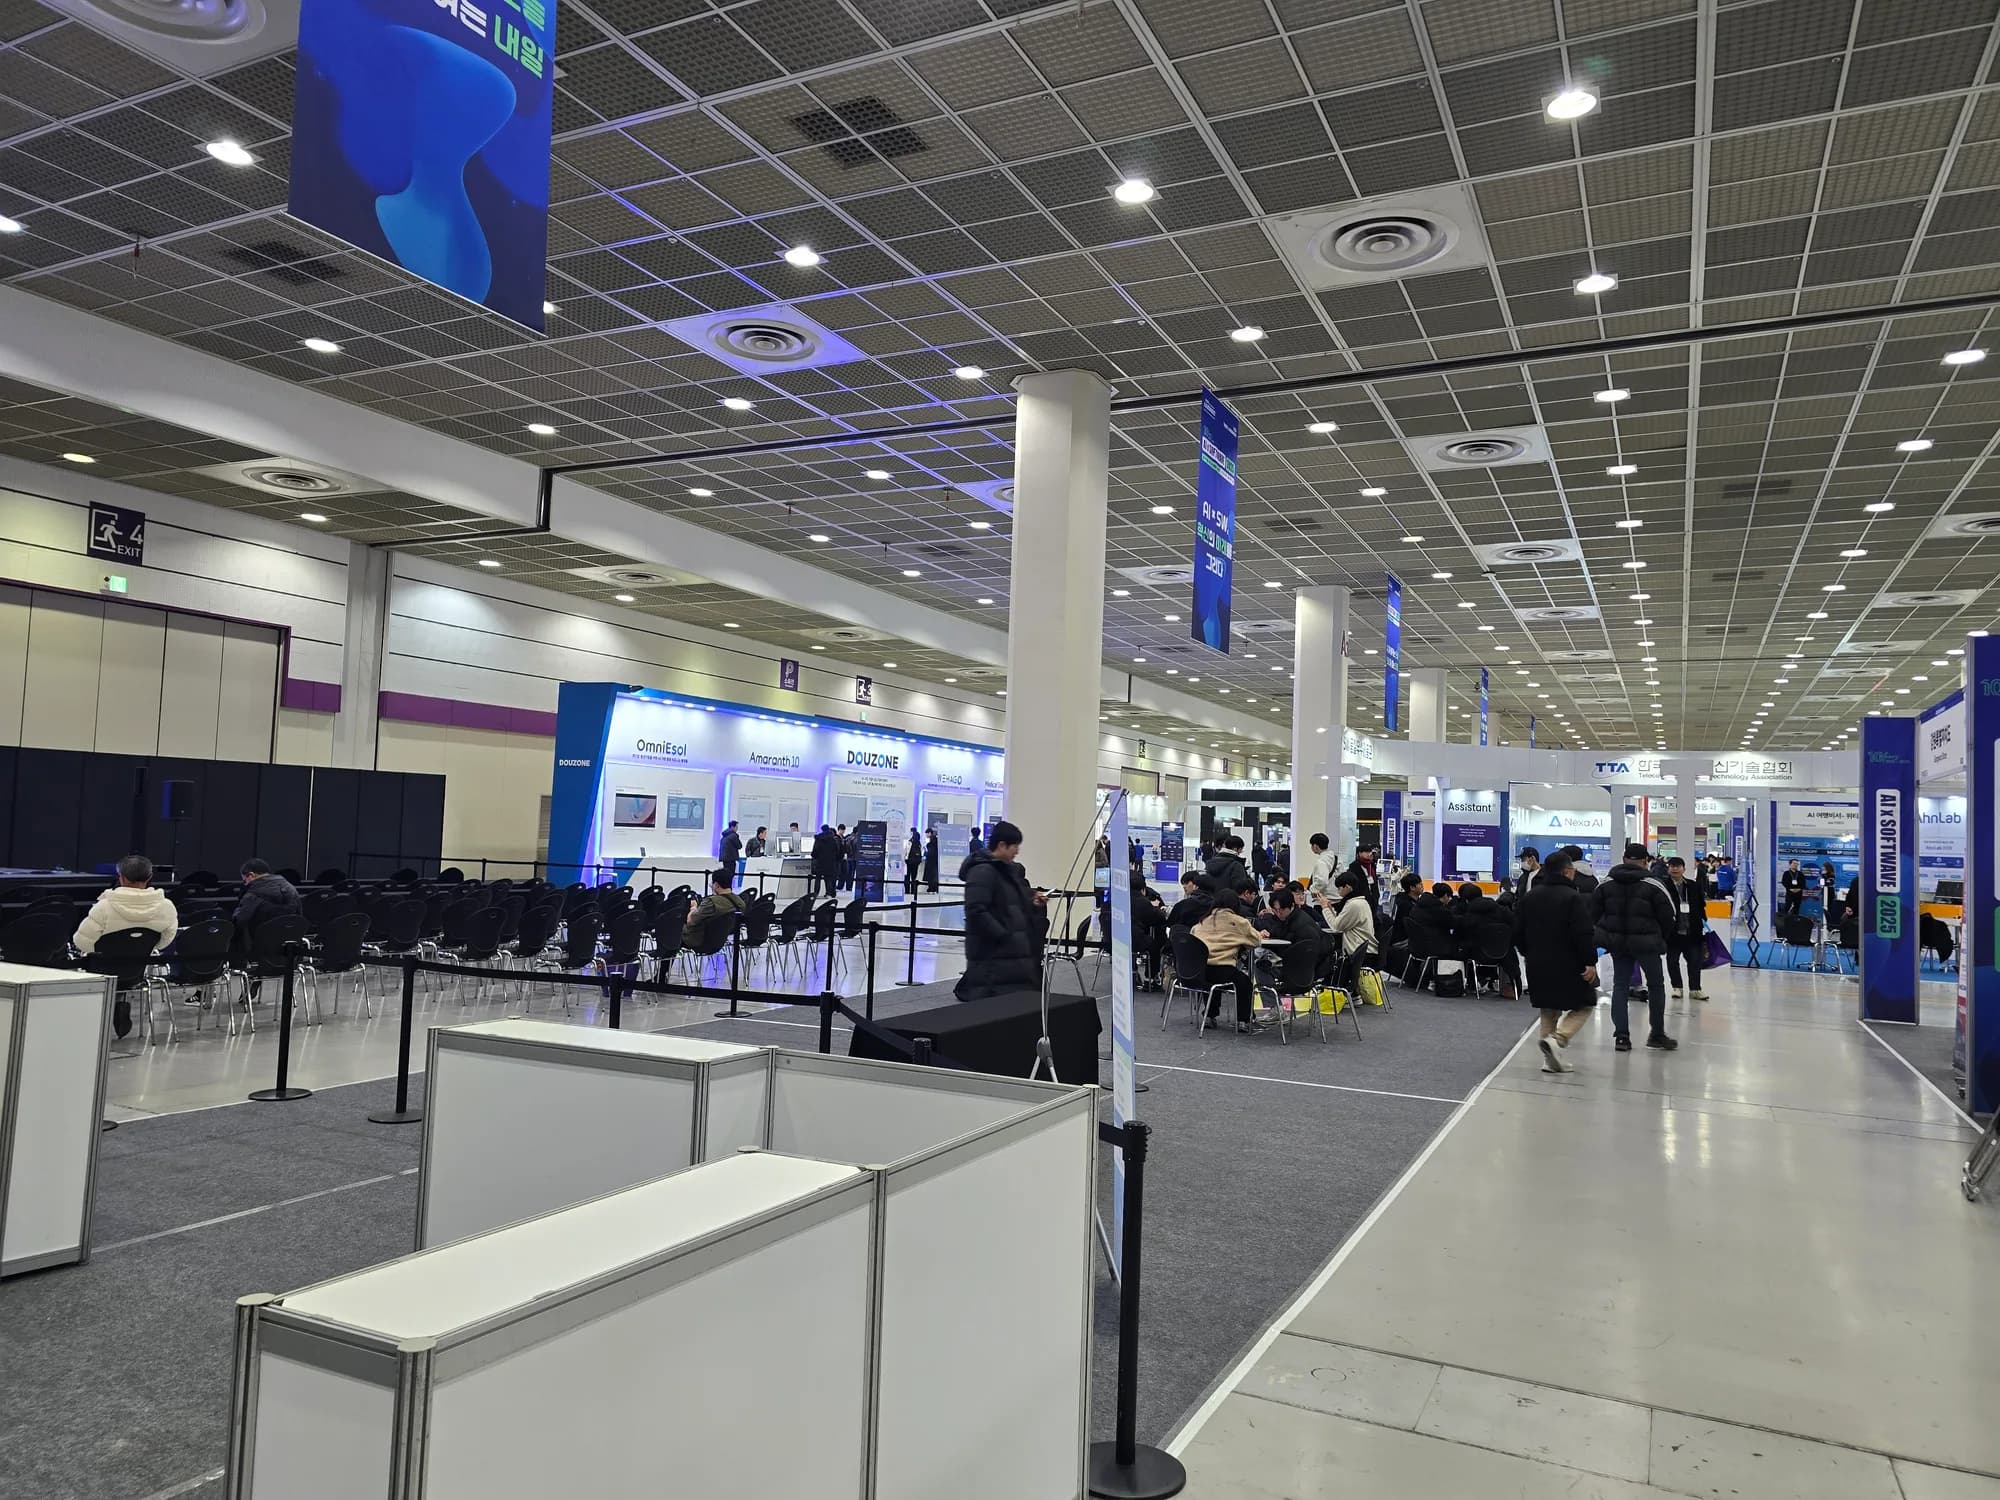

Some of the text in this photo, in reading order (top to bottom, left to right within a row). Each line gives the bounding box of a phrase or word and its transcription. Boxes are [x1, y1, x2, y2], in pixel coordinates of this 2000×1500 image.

[494, 14, 543, 79] 내일
[1203, 500, 1211, 520] AI
[129, 524, 143, 545] 4
[117, 544, 141, 558] EXIT
[636, 739, 687, 757] OmniEsol
[559, 759, 591, 767] DOUZONE
[847, 750, 899, 769] DOUZONE
[1595, 763, 1630, 772] TTA
[1448, 802, 1492, 812] Assistant
[1880, 793, 1896, 806] AI
[1564, 817, 1603, 828] Nexa AI
[1880, 819, 1896, 888] SOFTWAVE
[1879, 900, 1897, 934] 2025
